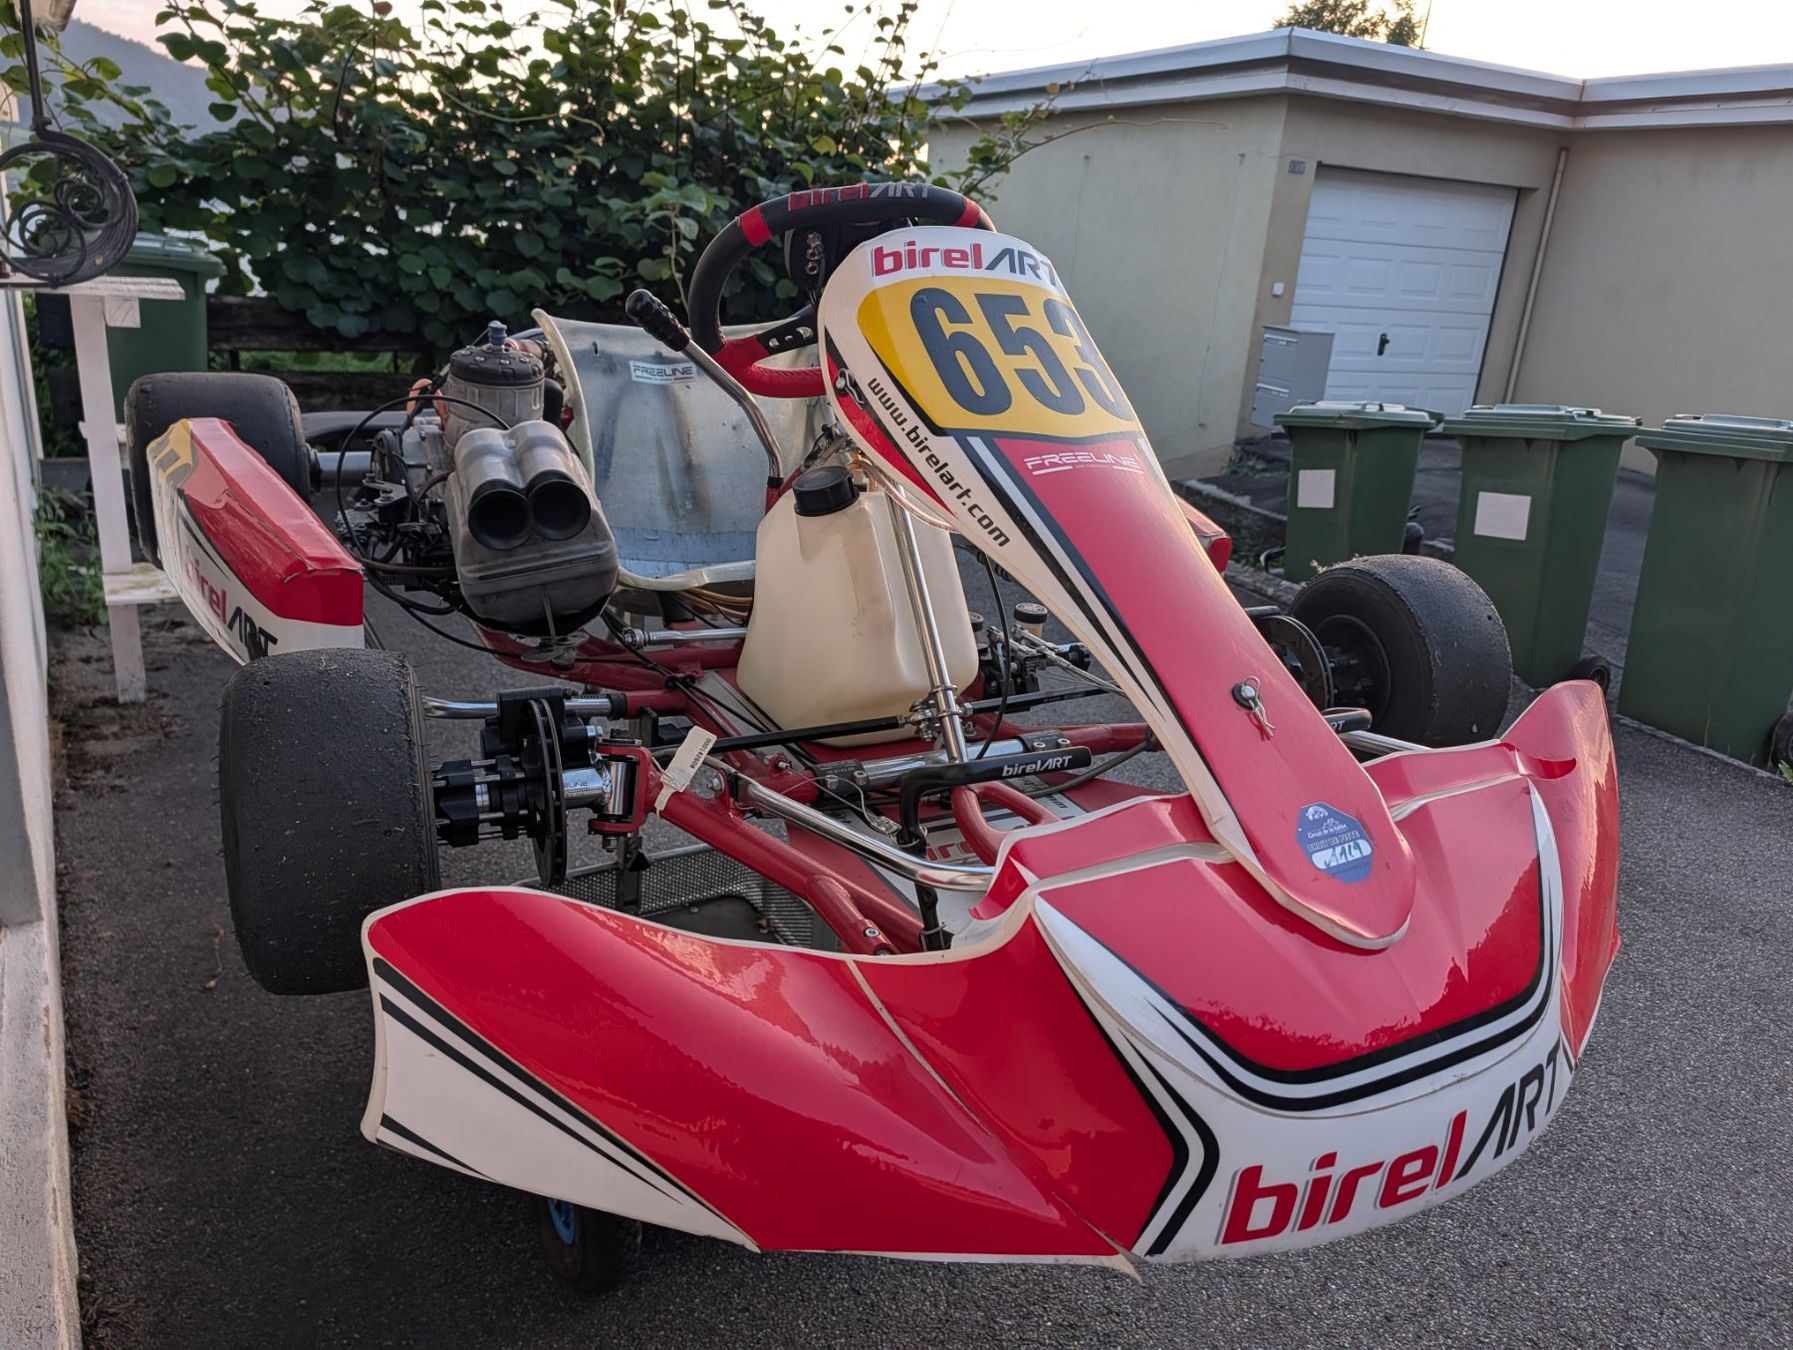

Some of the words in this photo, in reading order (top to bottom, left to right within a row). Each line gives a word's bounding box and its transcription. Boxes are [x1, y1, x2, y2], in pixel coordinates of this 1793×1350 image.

[632, 364, 693, 378] FREELINE
[910, 287, 1136, 422] 653
[867, 378, 1011, 548] www.birelart.com
[1023, 450, 1140, 470] FREELINE
[1001, 755, 1073, 777] birelART
[1215, 1035, 1573, 1245] birelART
